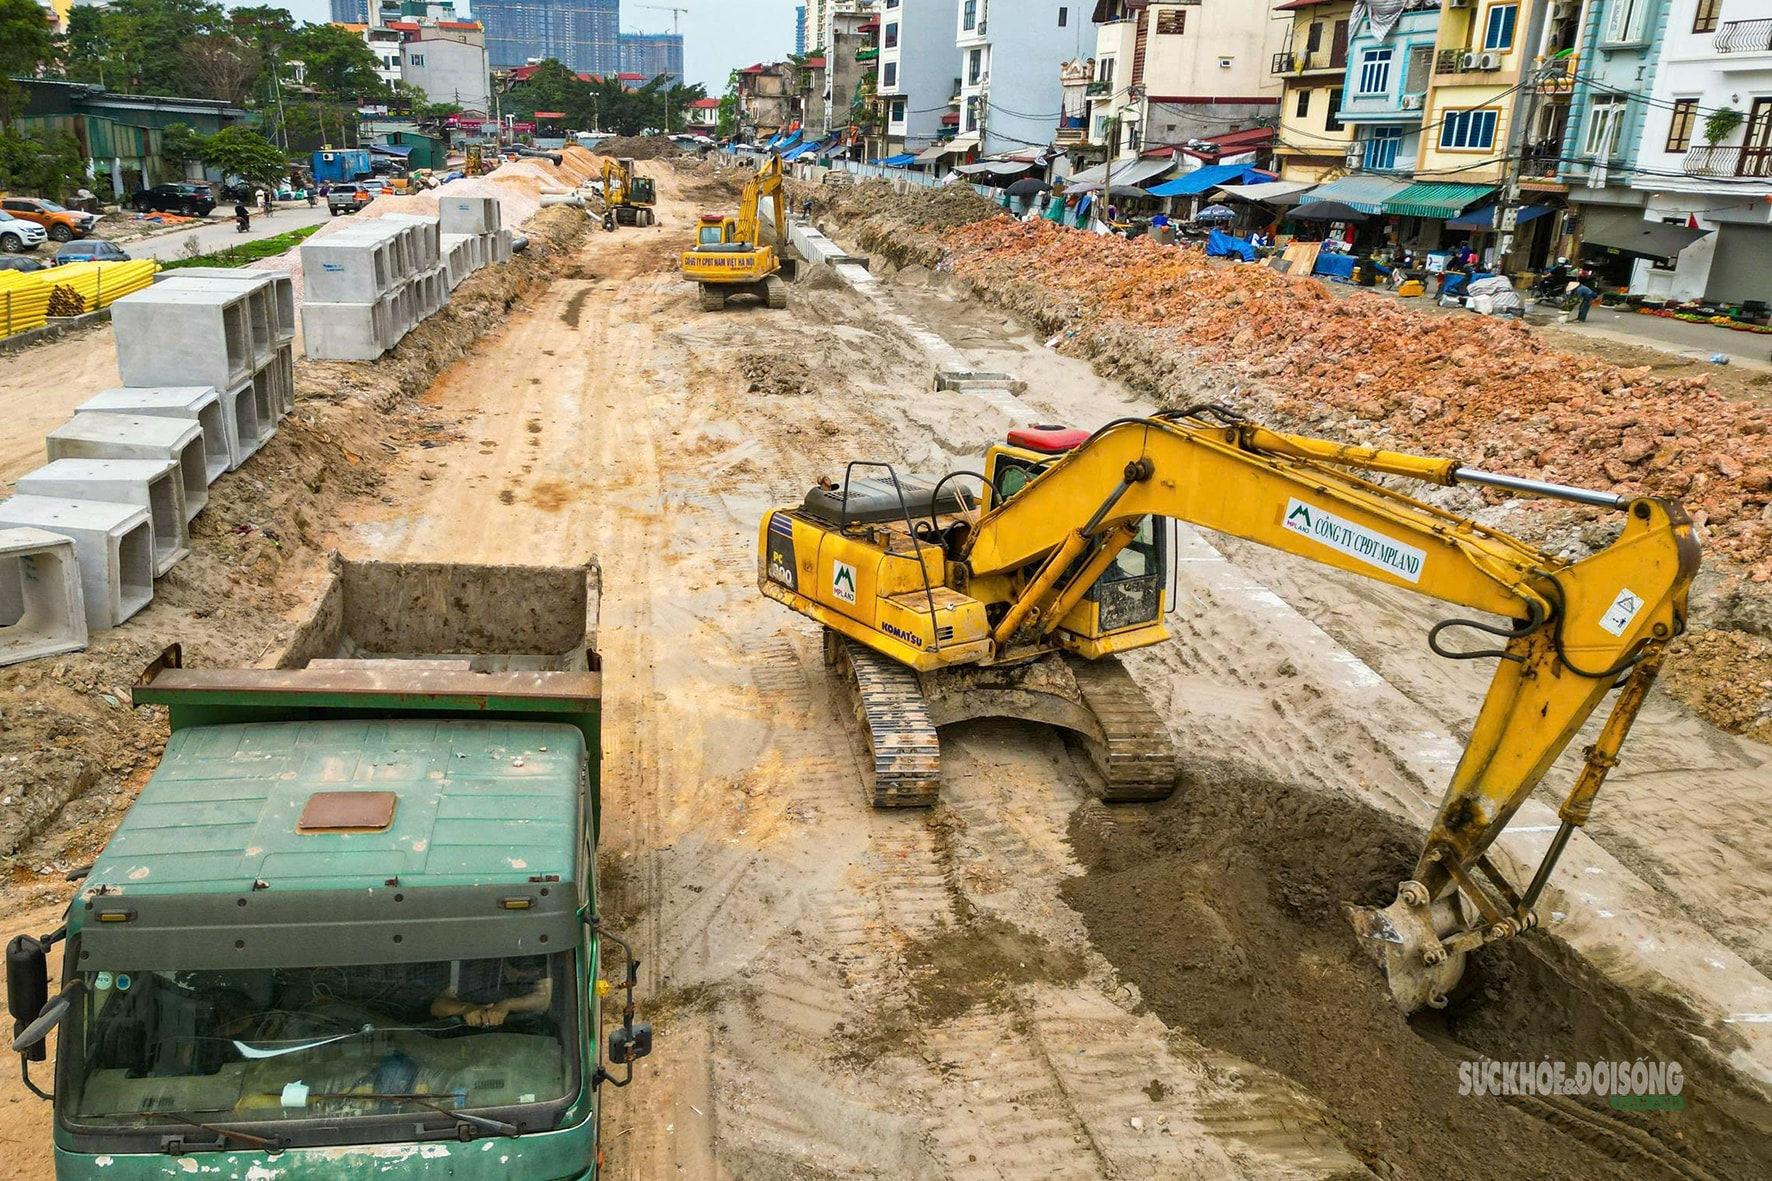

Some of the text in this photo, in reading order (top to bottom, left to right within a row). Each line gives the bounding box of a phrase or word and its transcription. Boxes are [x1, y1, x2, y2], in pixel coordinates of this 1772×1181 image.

[1315, 515, 1420, 575] CÔNG TY CPĐT MPLAND
[773, 551, 783, 564] PC
[833, 587, 855, 602] MPLAND
[881, 621, 923, 648] KOMATSU
